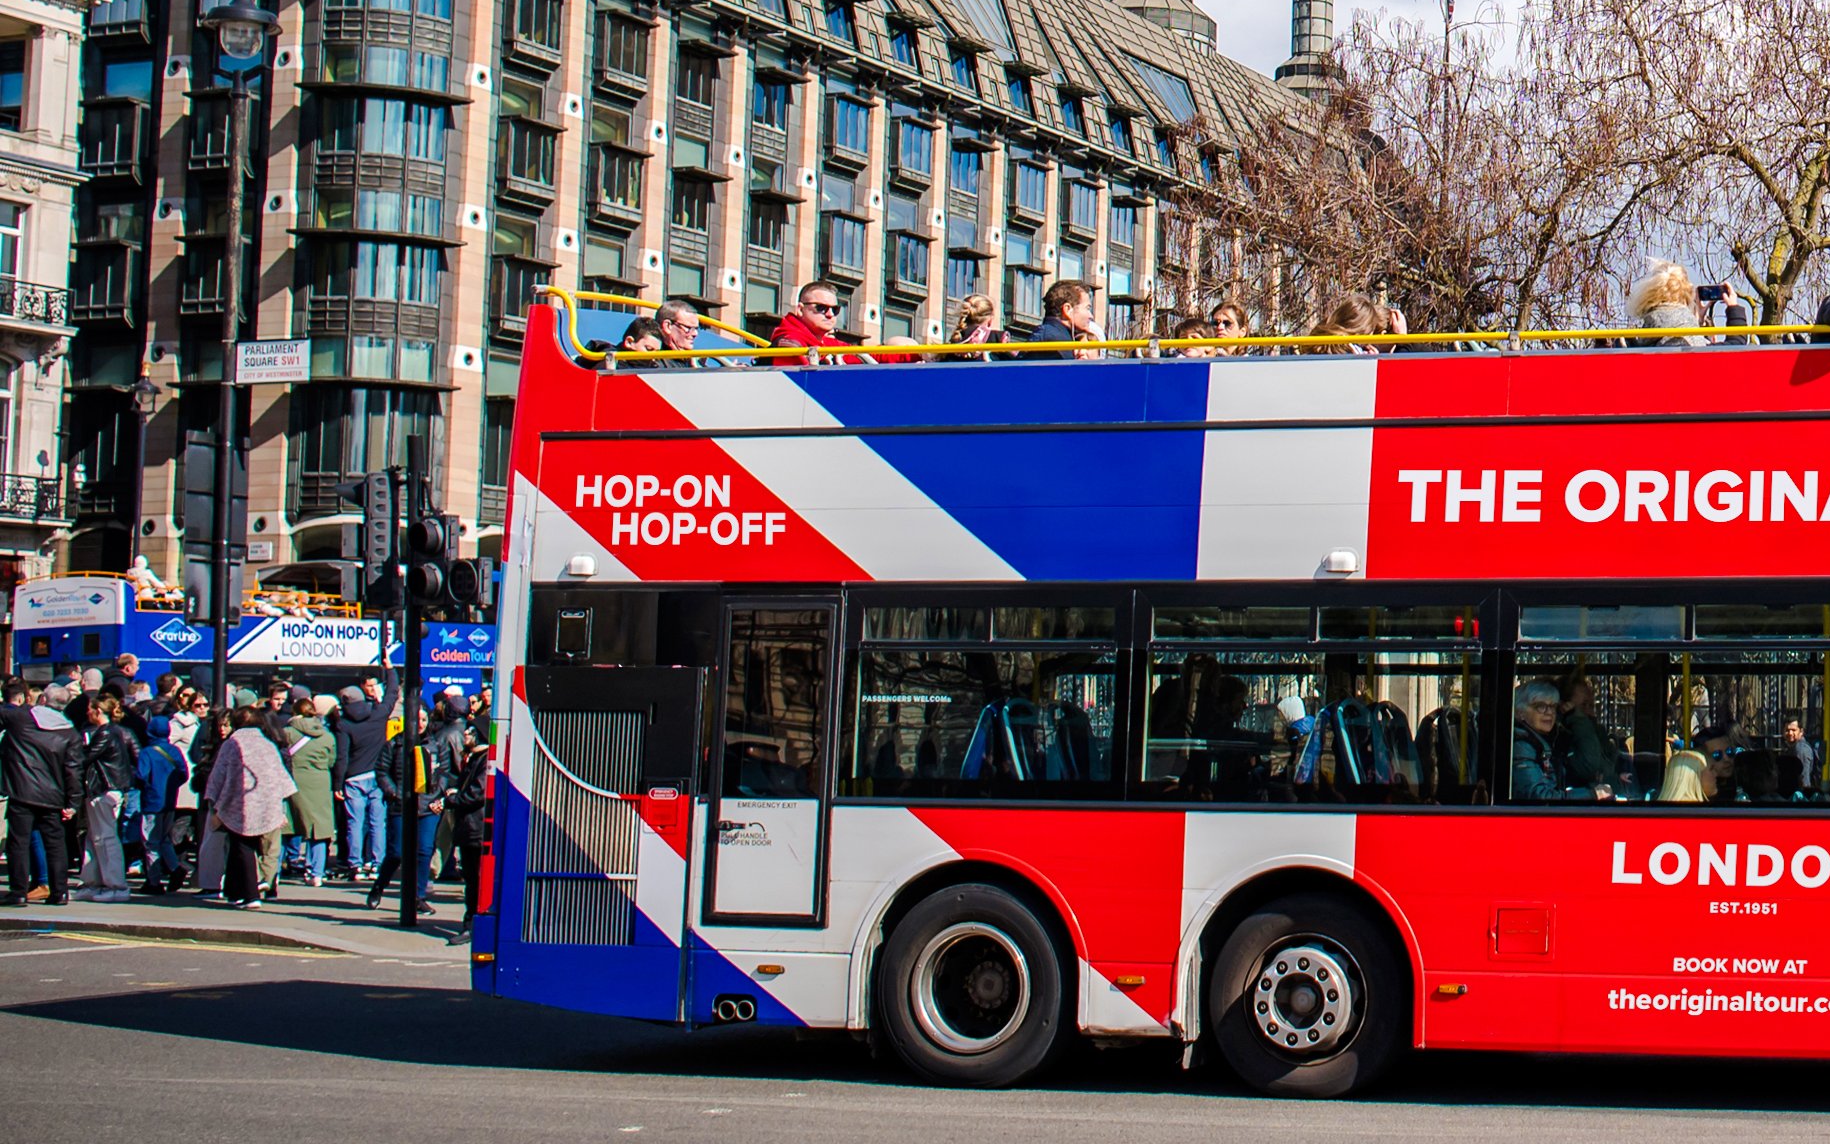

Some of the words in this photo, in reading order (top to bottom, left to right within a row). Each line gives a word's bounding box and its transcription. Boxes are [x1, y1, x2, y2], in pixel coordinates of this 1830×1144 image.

[245, 344, 299, 355] PARLIAMENT
[244, 357, 278, 367] SQUARE
[281, 356, 300, 365] SW1
[575, 474, 731, 508] HOP-ON
[1398, 469, 1543, 523] THE
[611, 512, 786, 546] HOP-OFF
[282, 624, 333, 638] HOP-ON
[337, 626, 391, 640] HOP-O
[282, 642, 345, 657] LONDON
[1709, 901, 1778, 914] EST.1951
[1673, 957, 1728, 973] BOOK
[1732, 959, 1780, 974] NOW
[1782, 959, 1808, 974] AT
